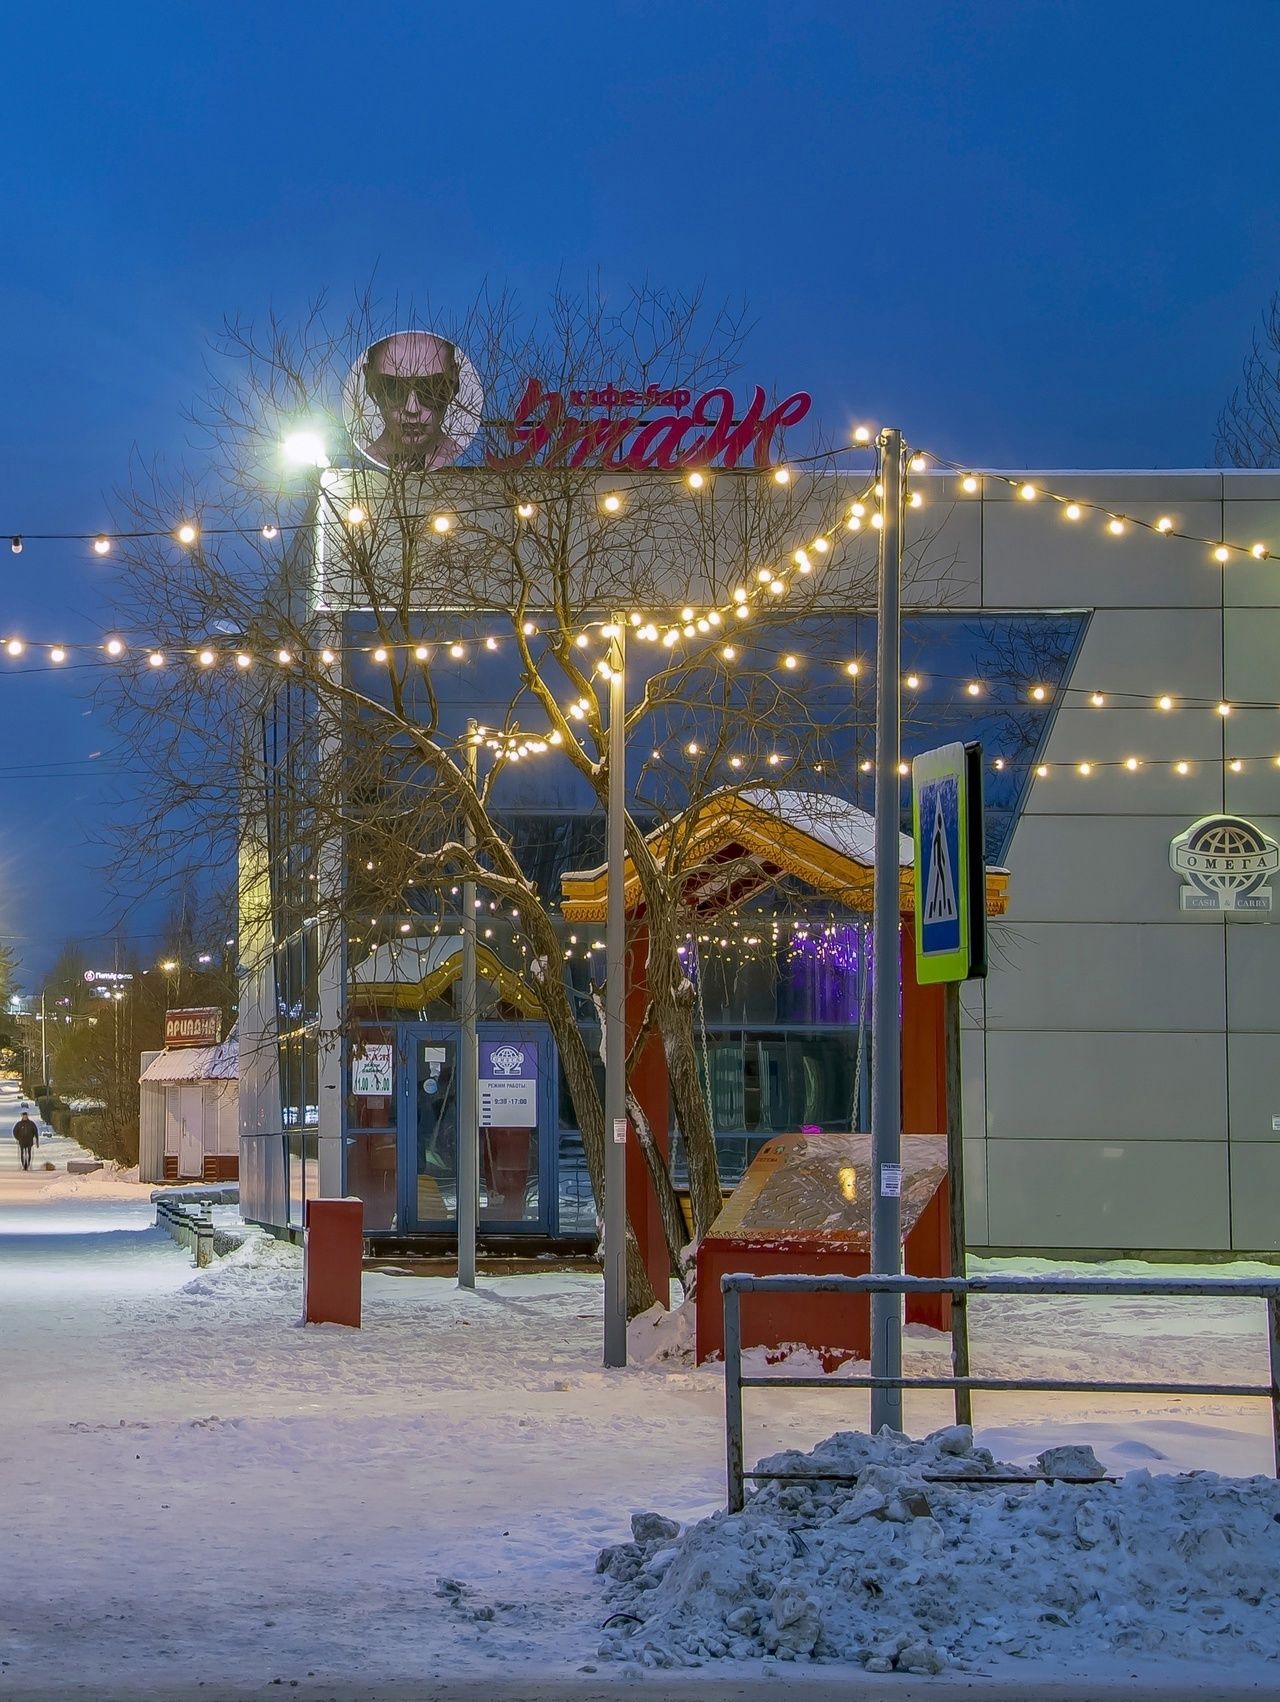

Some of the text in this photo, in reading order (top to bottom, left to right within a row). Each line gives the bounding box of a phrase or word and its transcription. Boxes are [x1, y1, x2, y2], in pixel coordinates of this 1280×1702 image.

[570, 382, 691, 411] кафе-бар
[1187, 856, 1267, 870] ОМЕГА
[1192, 899, 1216, 907] CASH
[1237, 900, 1267, 908] CARRY
